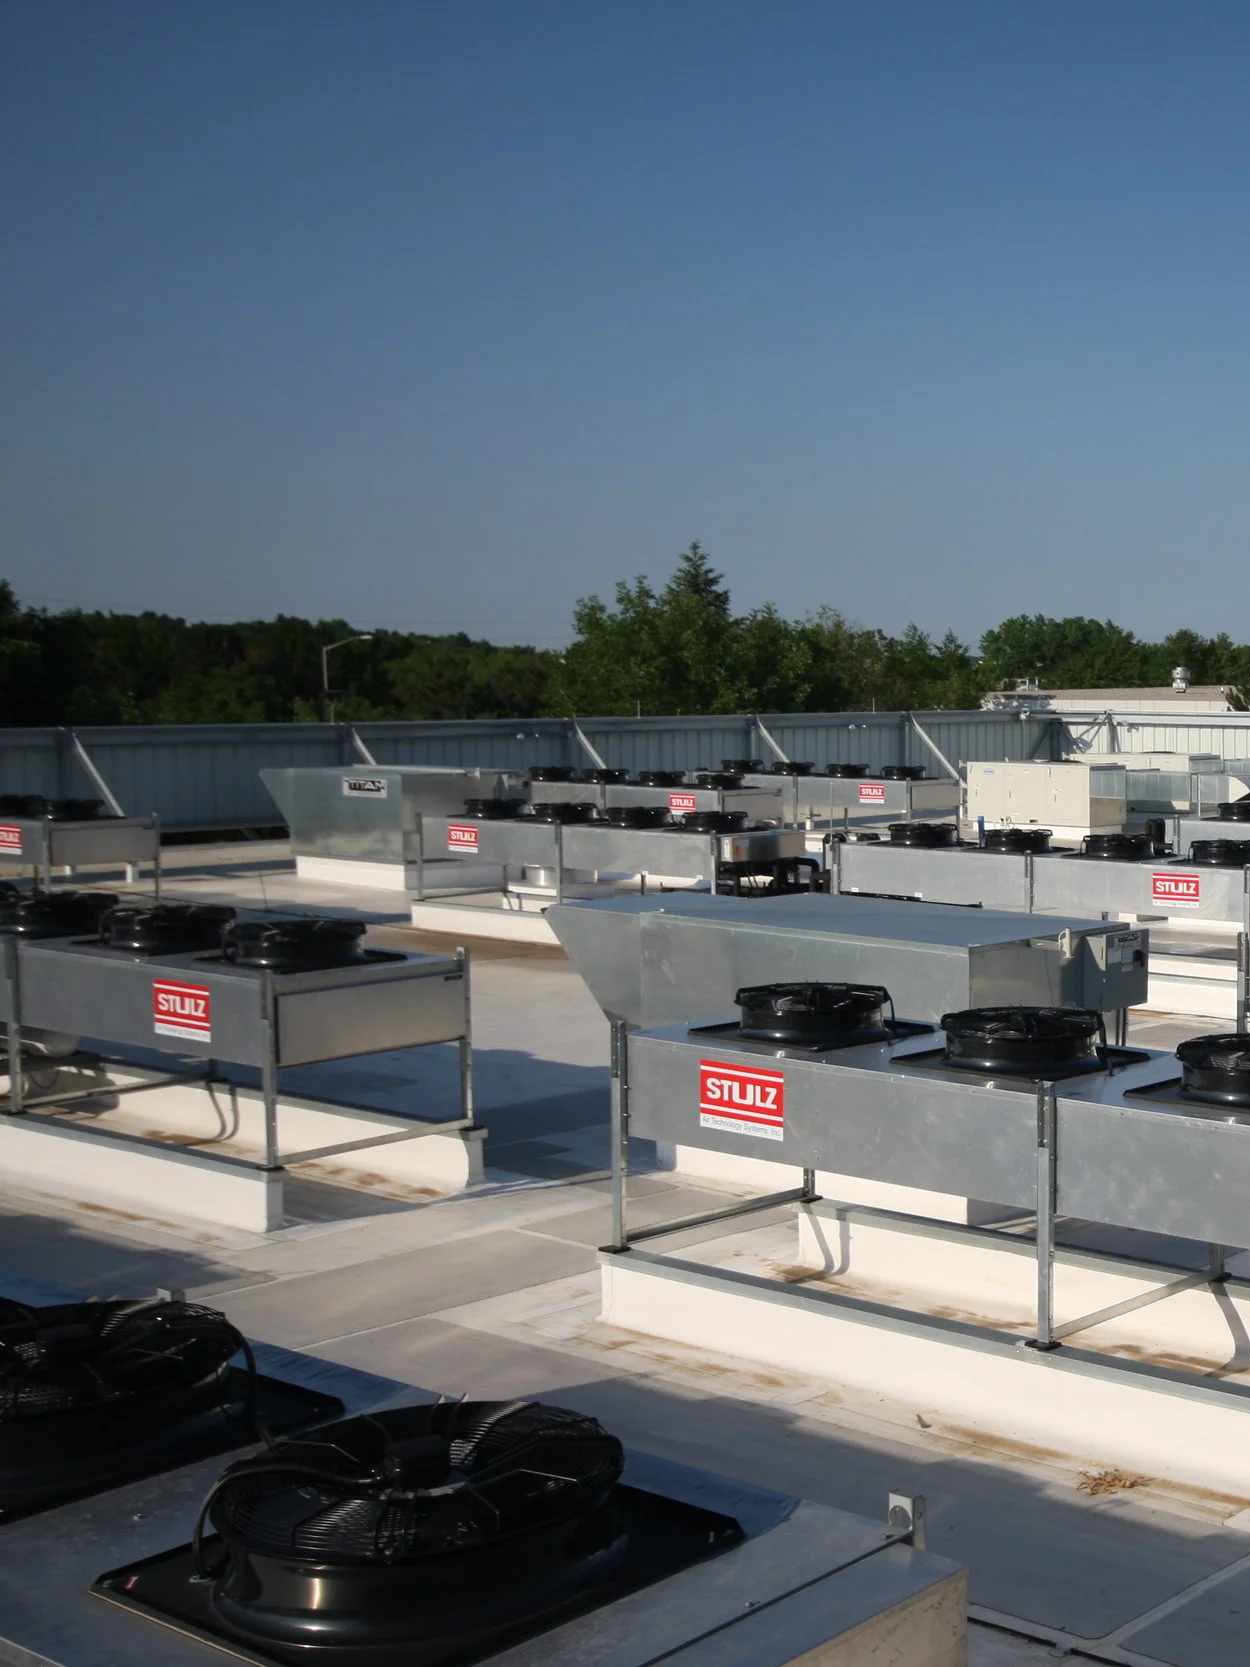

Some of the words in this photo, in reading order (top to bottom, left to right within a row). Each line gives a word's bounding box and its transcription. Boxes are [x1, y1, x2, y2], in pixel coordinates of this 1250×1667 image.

[348, 780, 385, 790] TITAN
[861, 788, 882, 796] STULZ
[671, 798, 694, 807] STULZ
[450, 831, 476, 842] STULZ
[1155, 881, 1196, 894] STULZ
[157, 993, 206, 1017] STULZ
[706, 1077, 778, 1110] STULZ
[711, 1117, 742, 1131] Technology
[743, 1123, 769, 1135] Systems,
